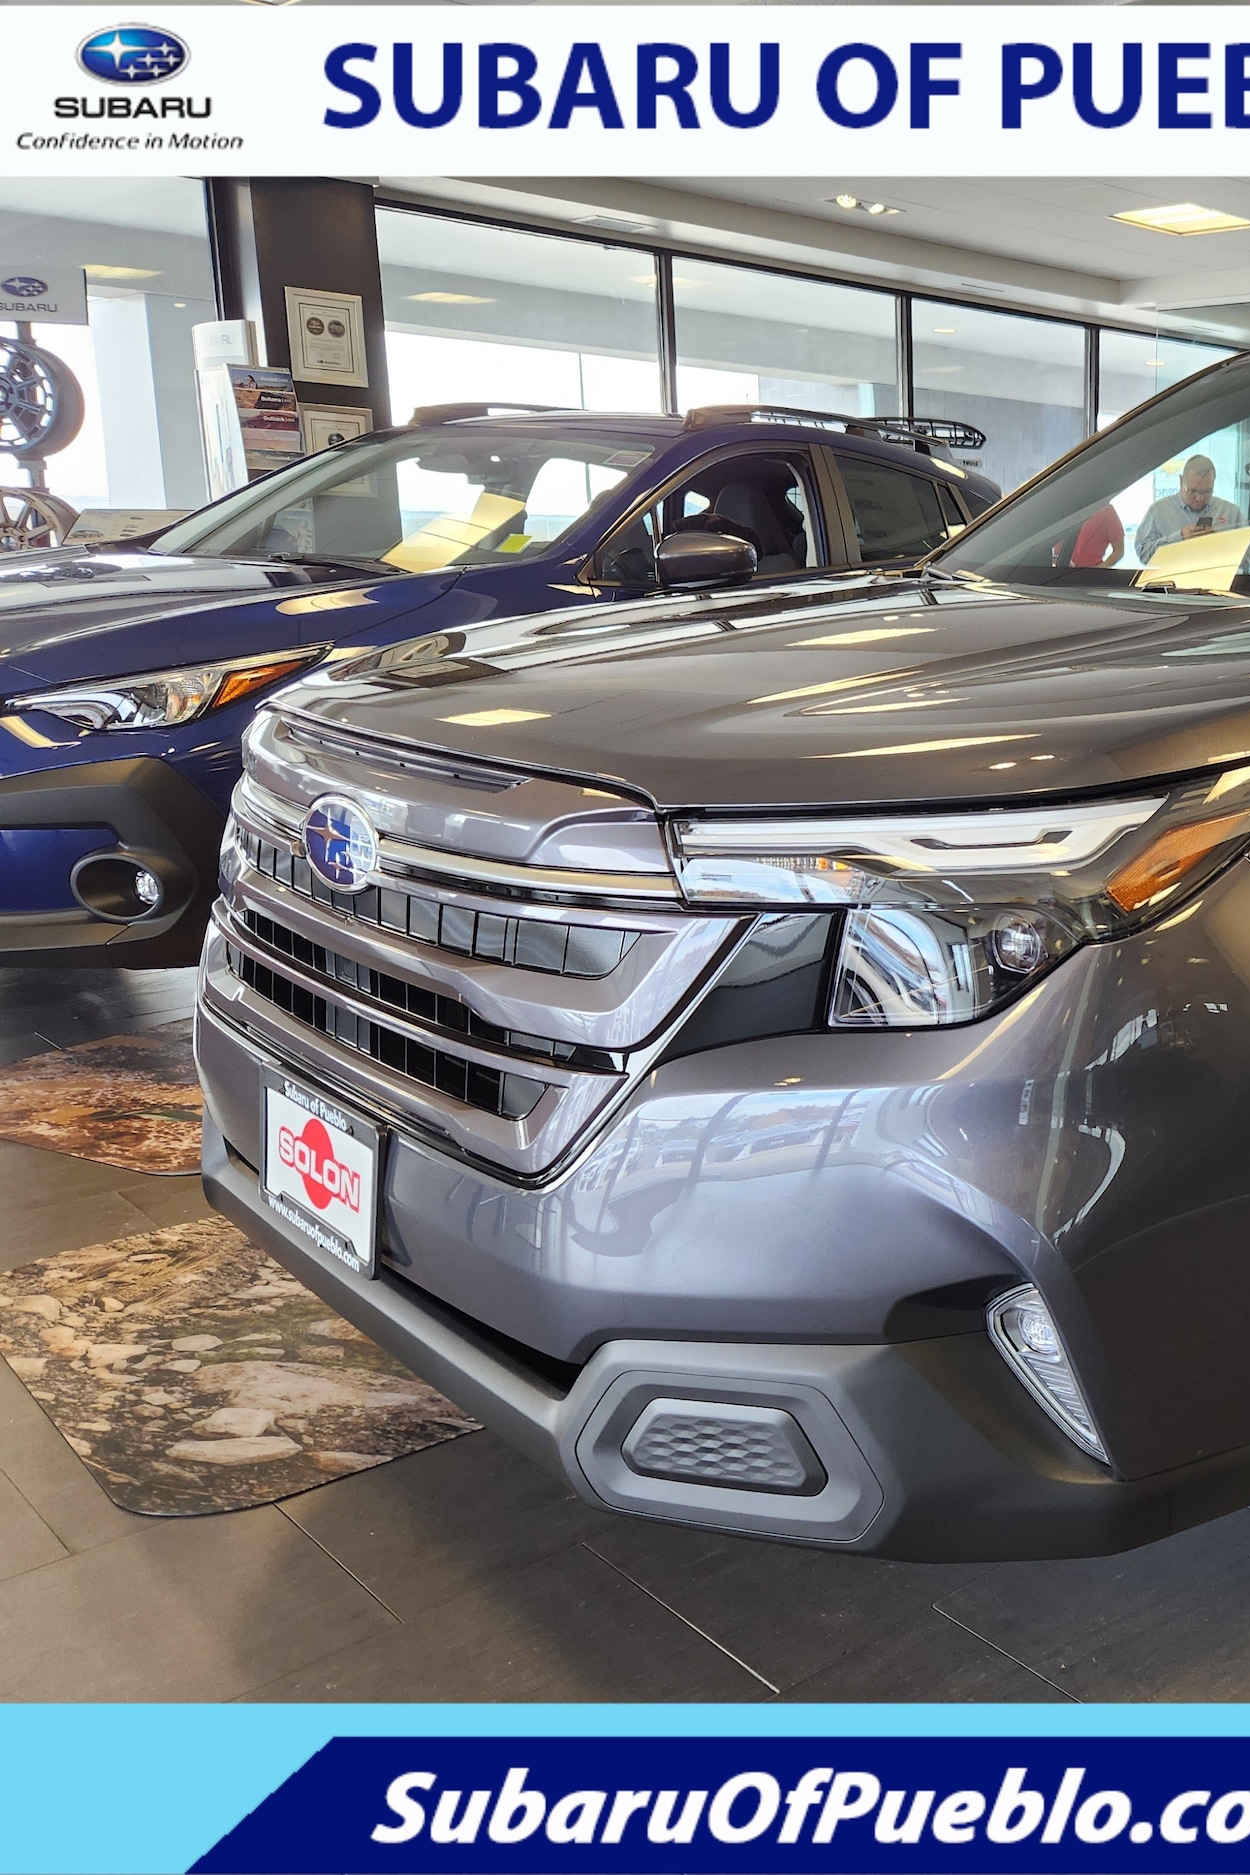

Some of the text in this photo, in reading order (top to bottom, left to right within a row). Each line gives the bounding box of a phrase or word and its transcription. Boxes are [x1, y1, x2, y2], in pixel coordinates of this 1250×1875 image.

[284, 1080, 348, 1132] Subaru of Pueblo
[278, 1126, 361, 1214] SOLON
[268, 1195, 360, 1273] www.subaruofpueblo.com
